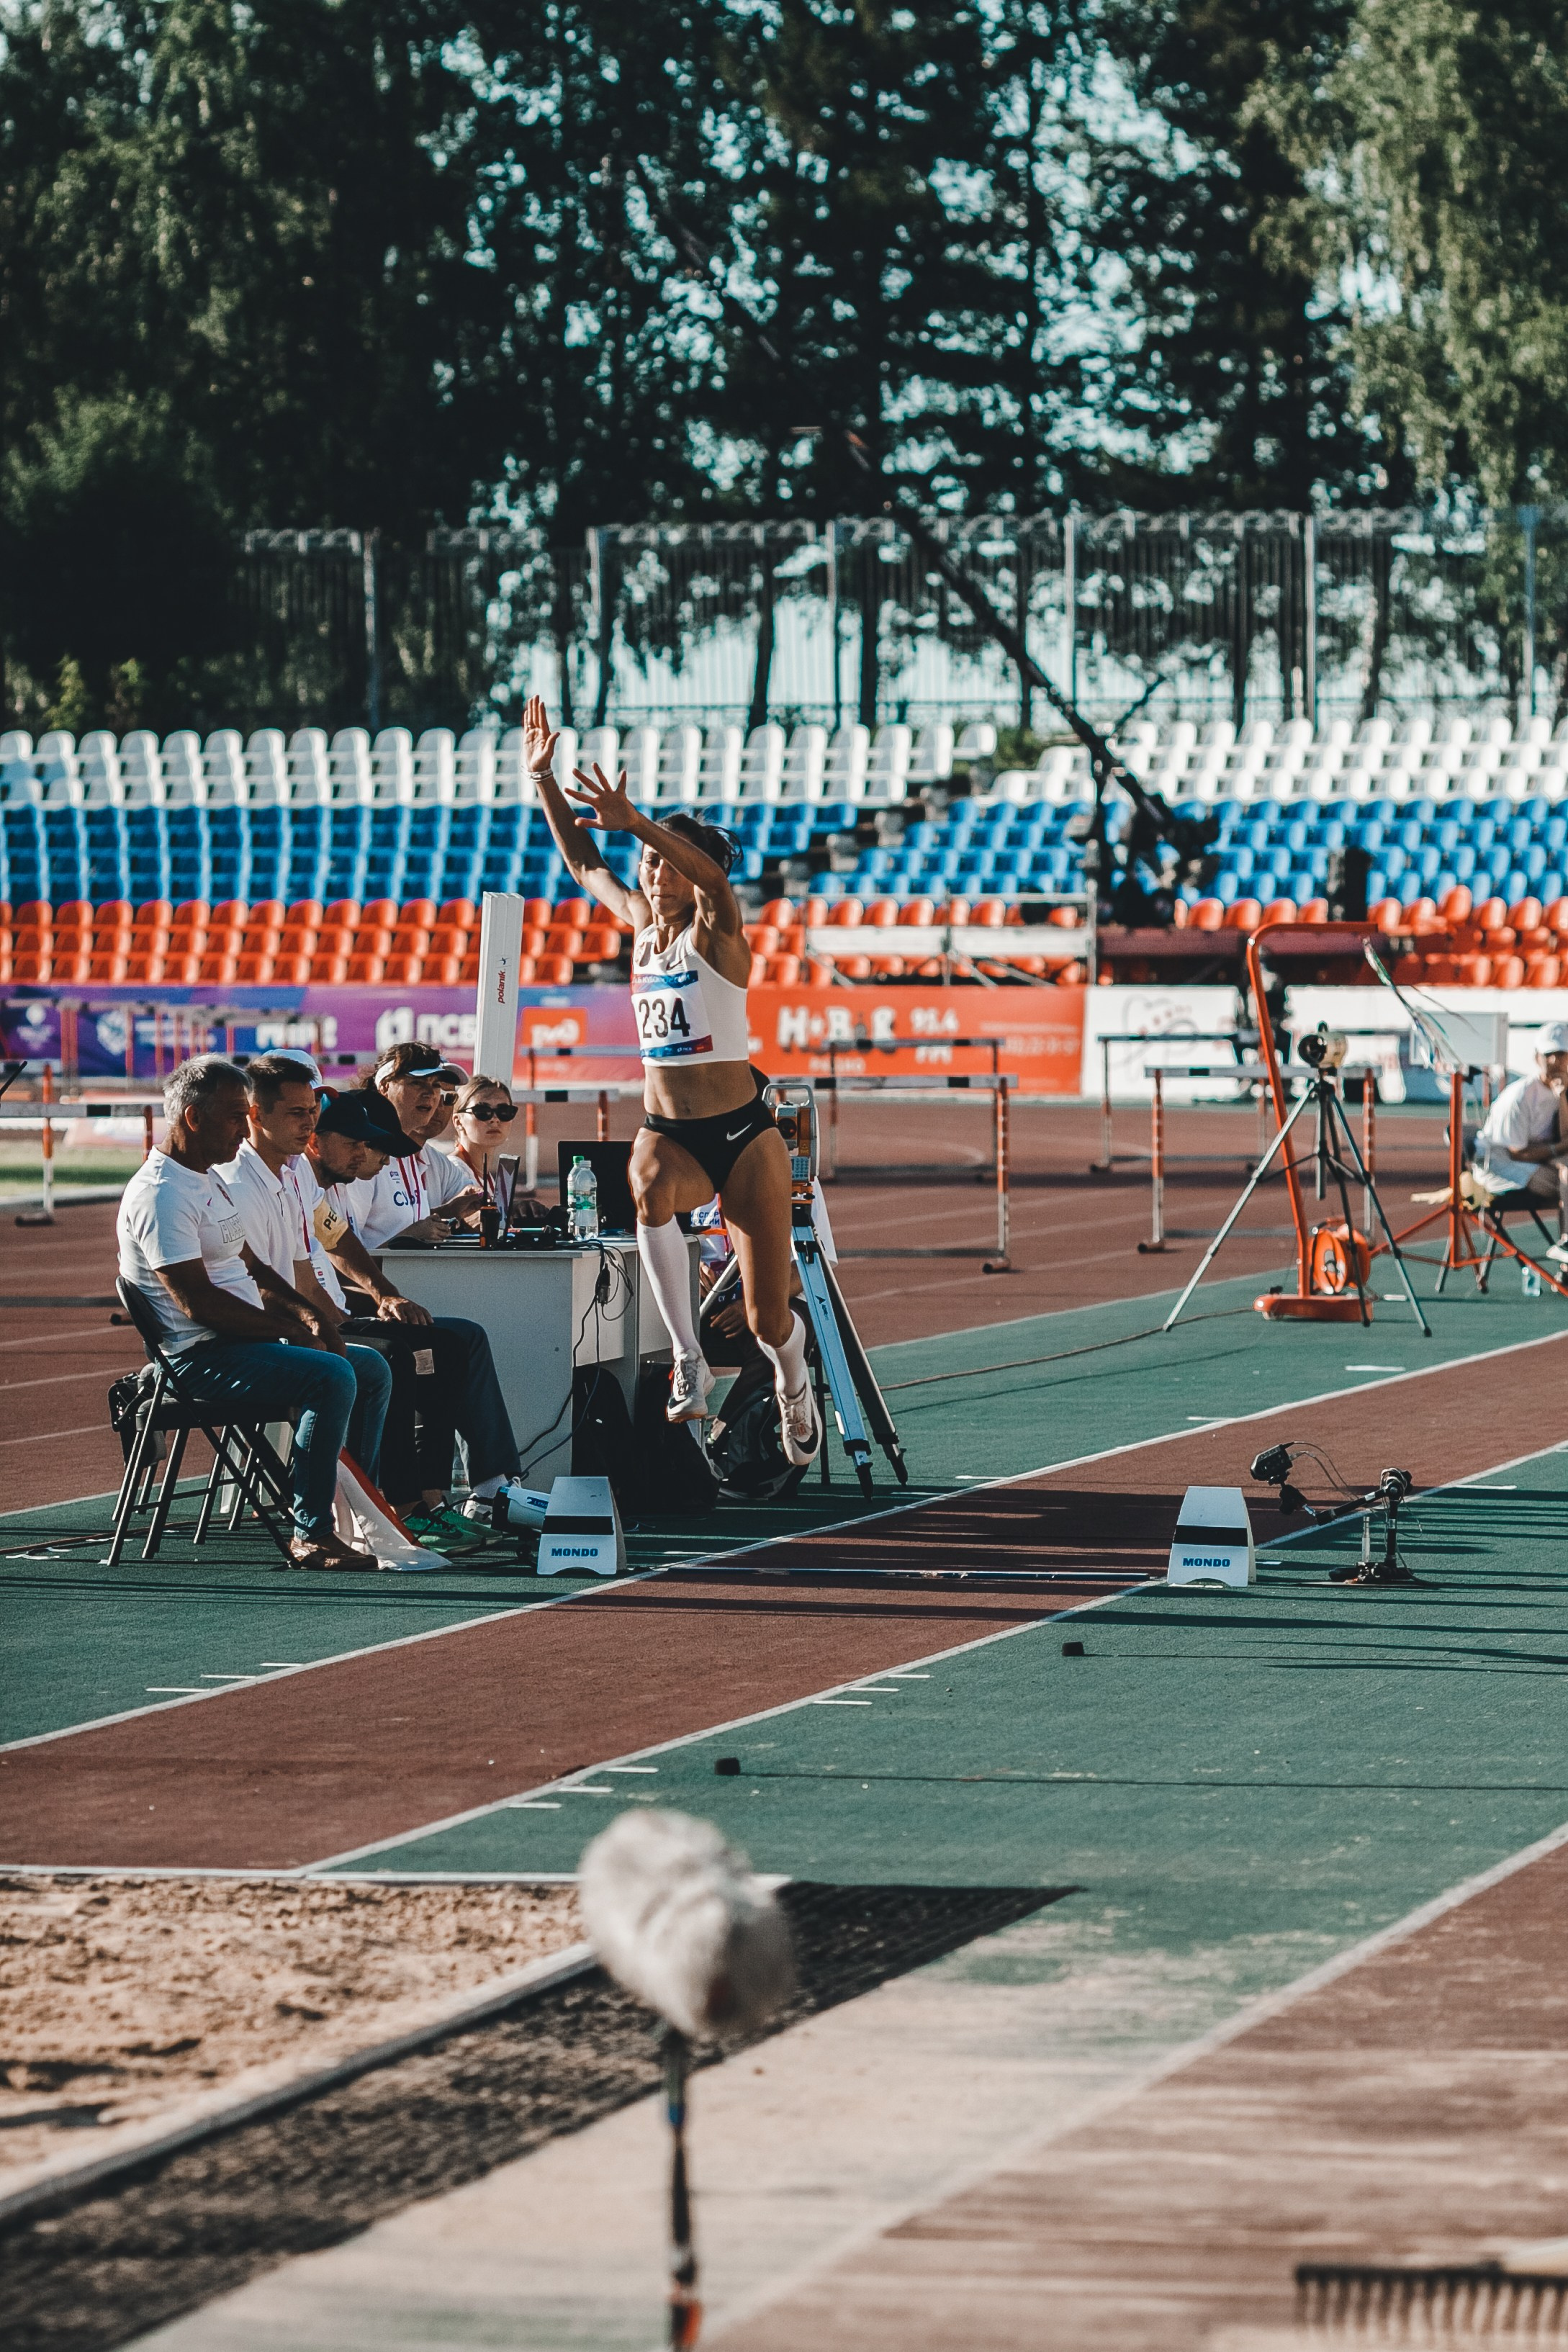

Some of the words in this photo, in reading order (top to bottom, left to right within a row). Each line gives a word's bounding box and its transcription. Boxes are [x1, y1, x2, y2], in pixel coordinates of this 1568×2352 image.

[639, 998, 690, 1038] 234
[551, 1548, 598, 1556] MONDO
[1183, 1557, 1230, 1567] MONDO
